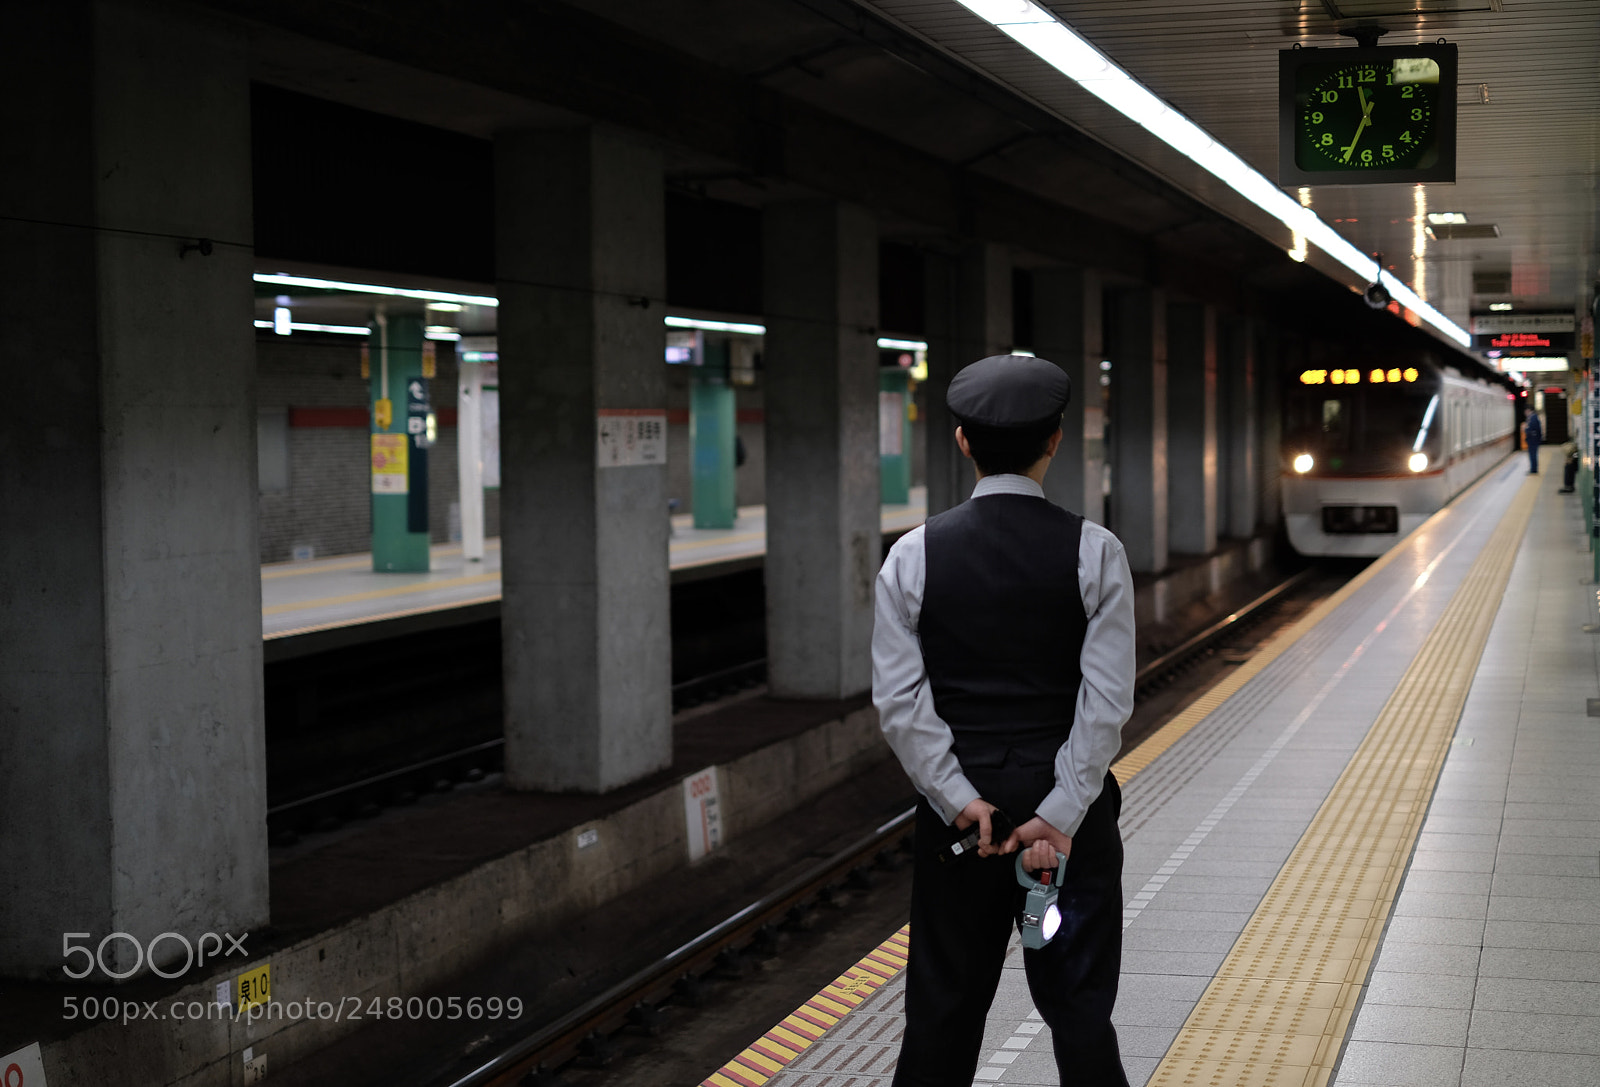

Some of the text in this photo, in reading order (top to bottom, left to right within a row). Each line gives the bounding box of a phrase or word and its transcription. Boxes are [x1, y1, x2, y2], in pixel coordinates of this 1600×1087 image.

[1338, 76, 1353, 88] 11
[1357, 70, 1376, 82] 12
[1385, 74, 1393, 86] 1
[1321, 90, 1339, 103] 10
[1401, 86, 1414, 98] 2
[1312, 112, 1324, 124] 9
[1411, 108, 1423, 121] 3
[1321, 133, 1334, 146] 8
[1399, 130, 1412, 143] 4
[1340, 146, 1352, 160] 7
[1361, 149, 1373, 162] 6
[1382, 145, 1394, 157] 5
